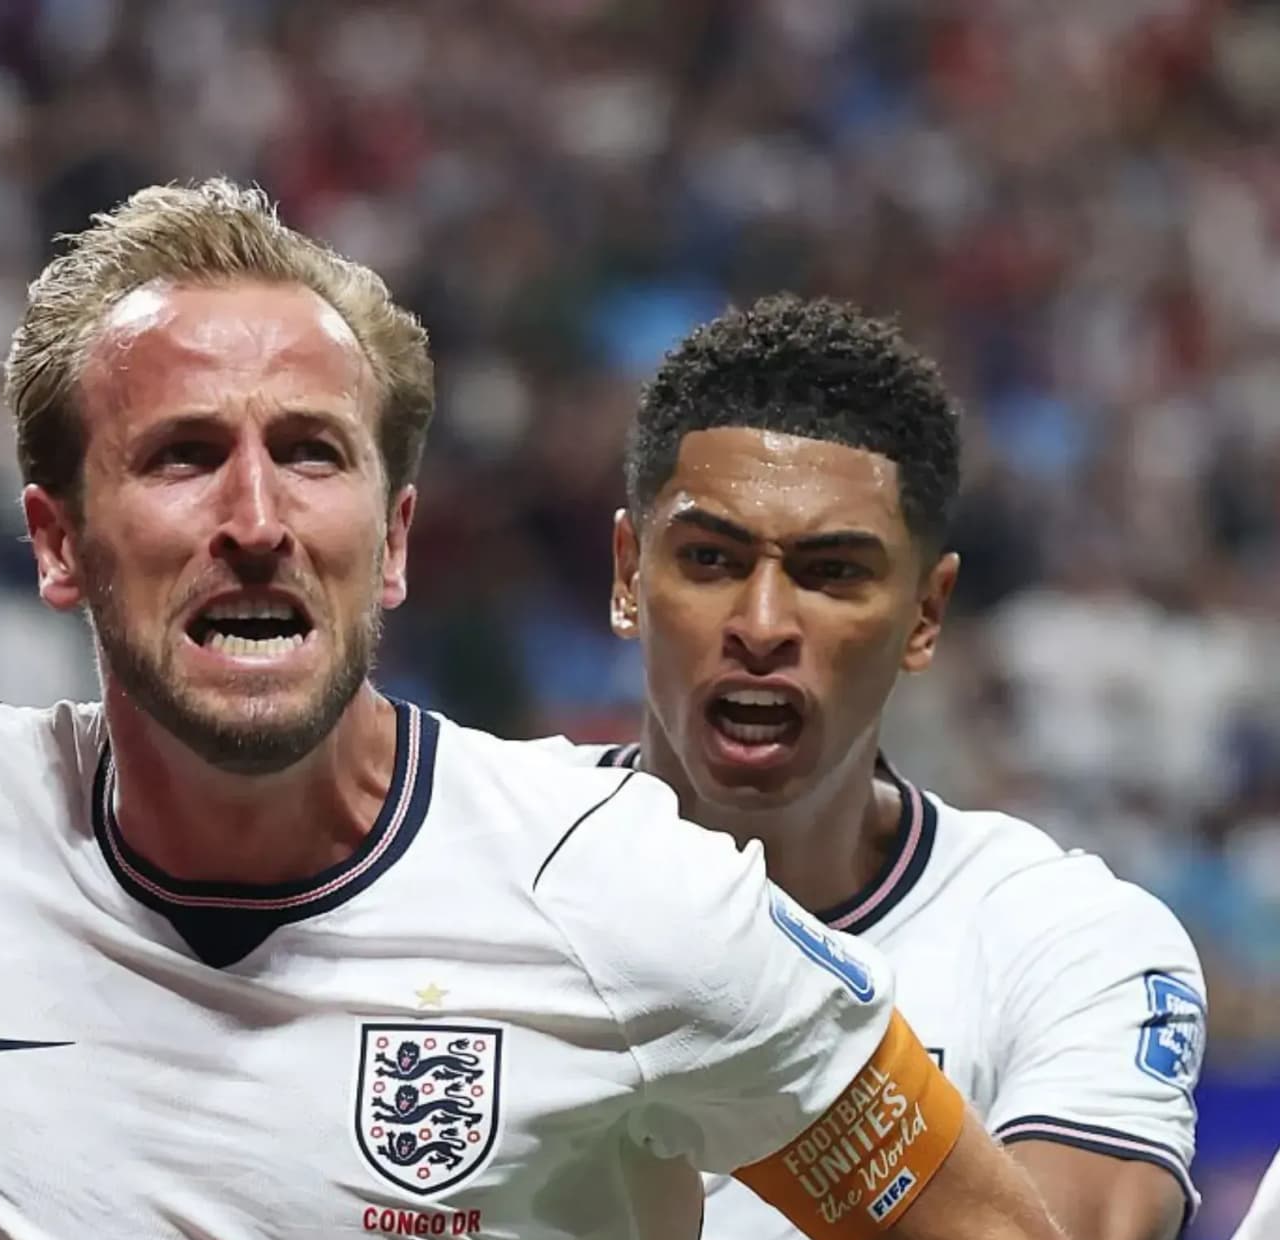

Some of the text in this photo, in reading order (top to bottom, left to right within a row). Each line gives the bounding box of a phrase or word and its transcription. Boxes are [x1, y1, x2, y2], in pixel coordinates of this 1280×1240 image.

[783, 1065, 890, 1175] FOOTBALL
[798, 1080, 907, 1198] UNITES
[818, 1101, 928, 1223] the World
[363, 1207, 481, 1236] CONGO DR
[872, 1174, 913, 1217] FIFA
